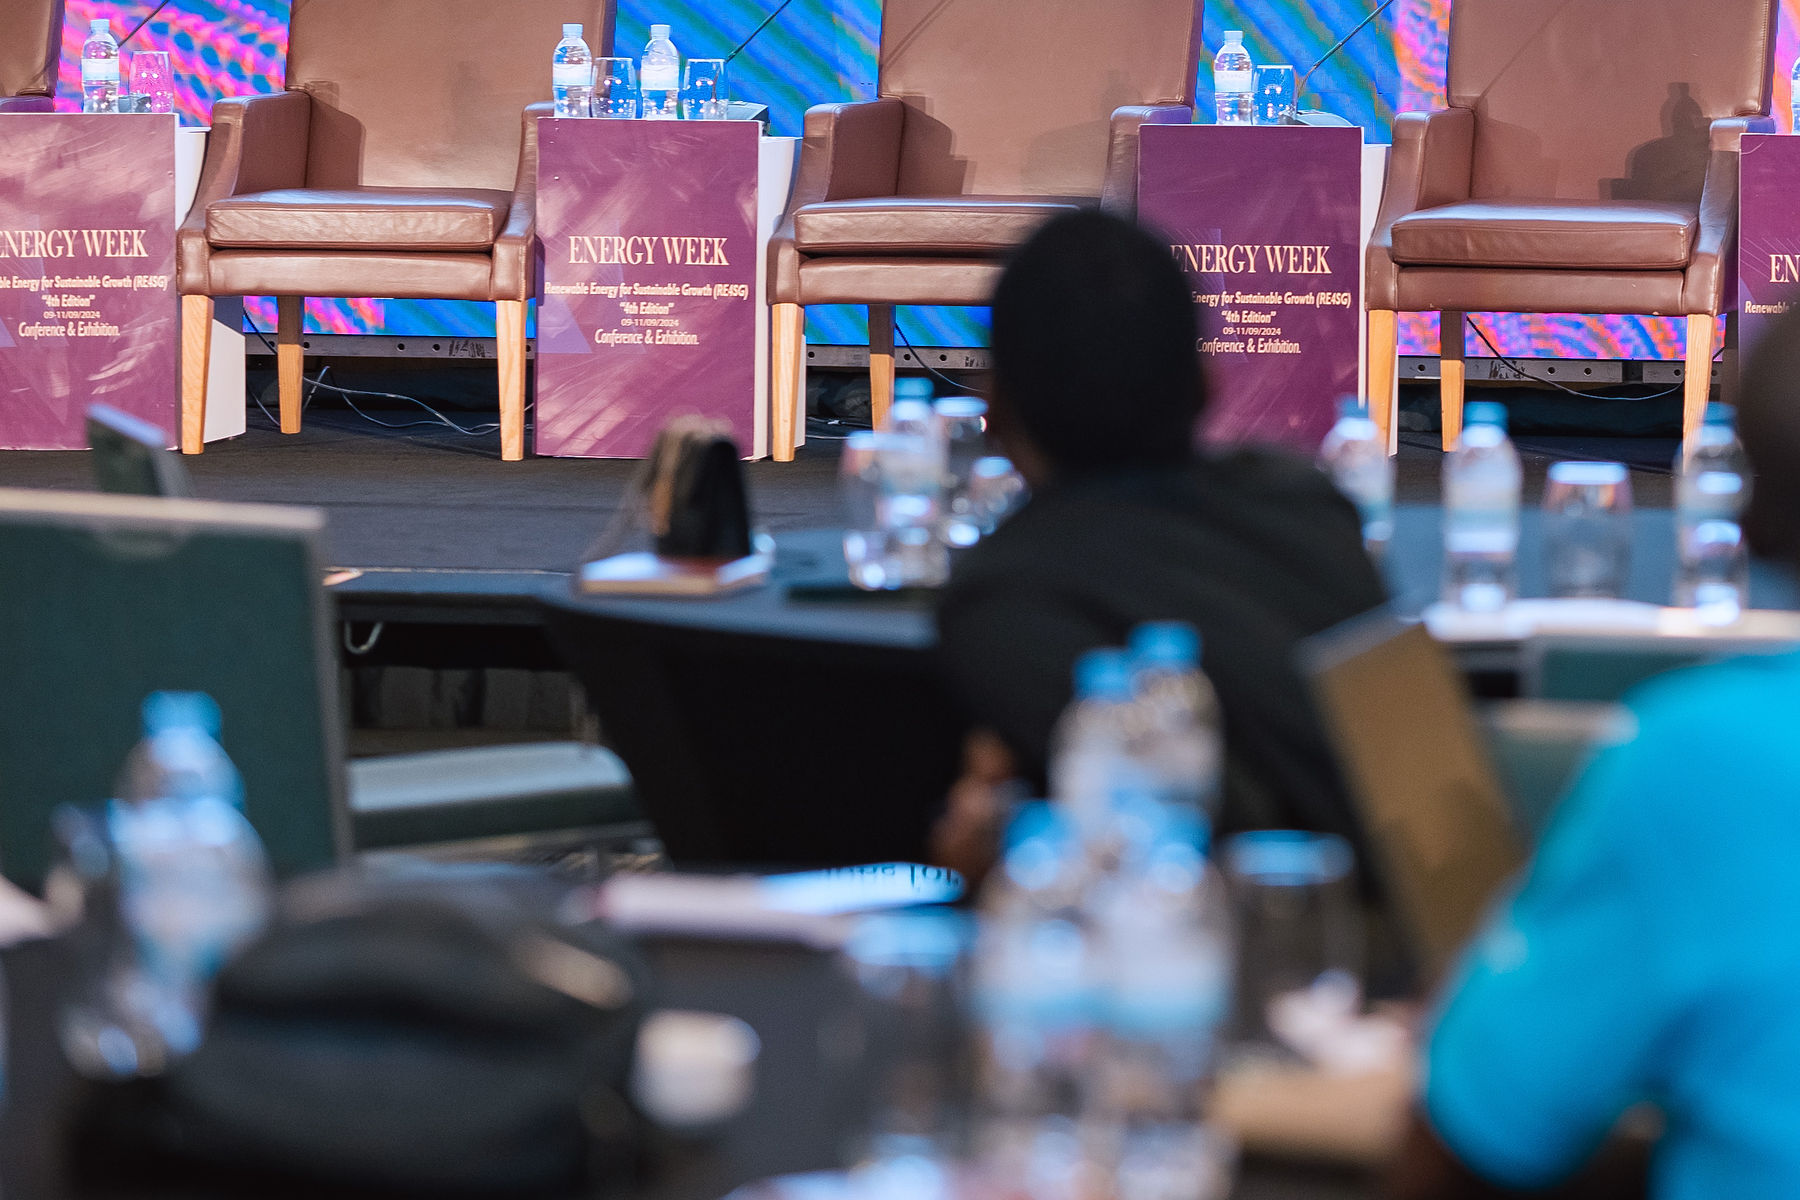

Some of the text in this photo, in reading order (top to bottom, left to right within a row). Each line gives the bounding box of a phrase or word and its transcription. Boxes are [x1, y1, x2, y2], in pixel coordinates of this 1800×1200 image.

[83, 229, 149, 258] WEEK
[569, 236, 730, 266] ENERGY WEEK
[1264, 245, 1332, 274] WEEK
[590, 282, 618, 298] Energy
[620, 282, 632, 298] for
[633, 283, 681, 296] Sustainable
[682, 284, 712, 297] Growth
[713, 284, 749, 300] (RE4SG)
[1192, 291, 1352, 308] Energy for Sustainable Growth (RE4SG)
[1222, 327, 1282, 336] 09-11/09/2024
[1196, 337, 1302, 356] Conference Exhibition.
